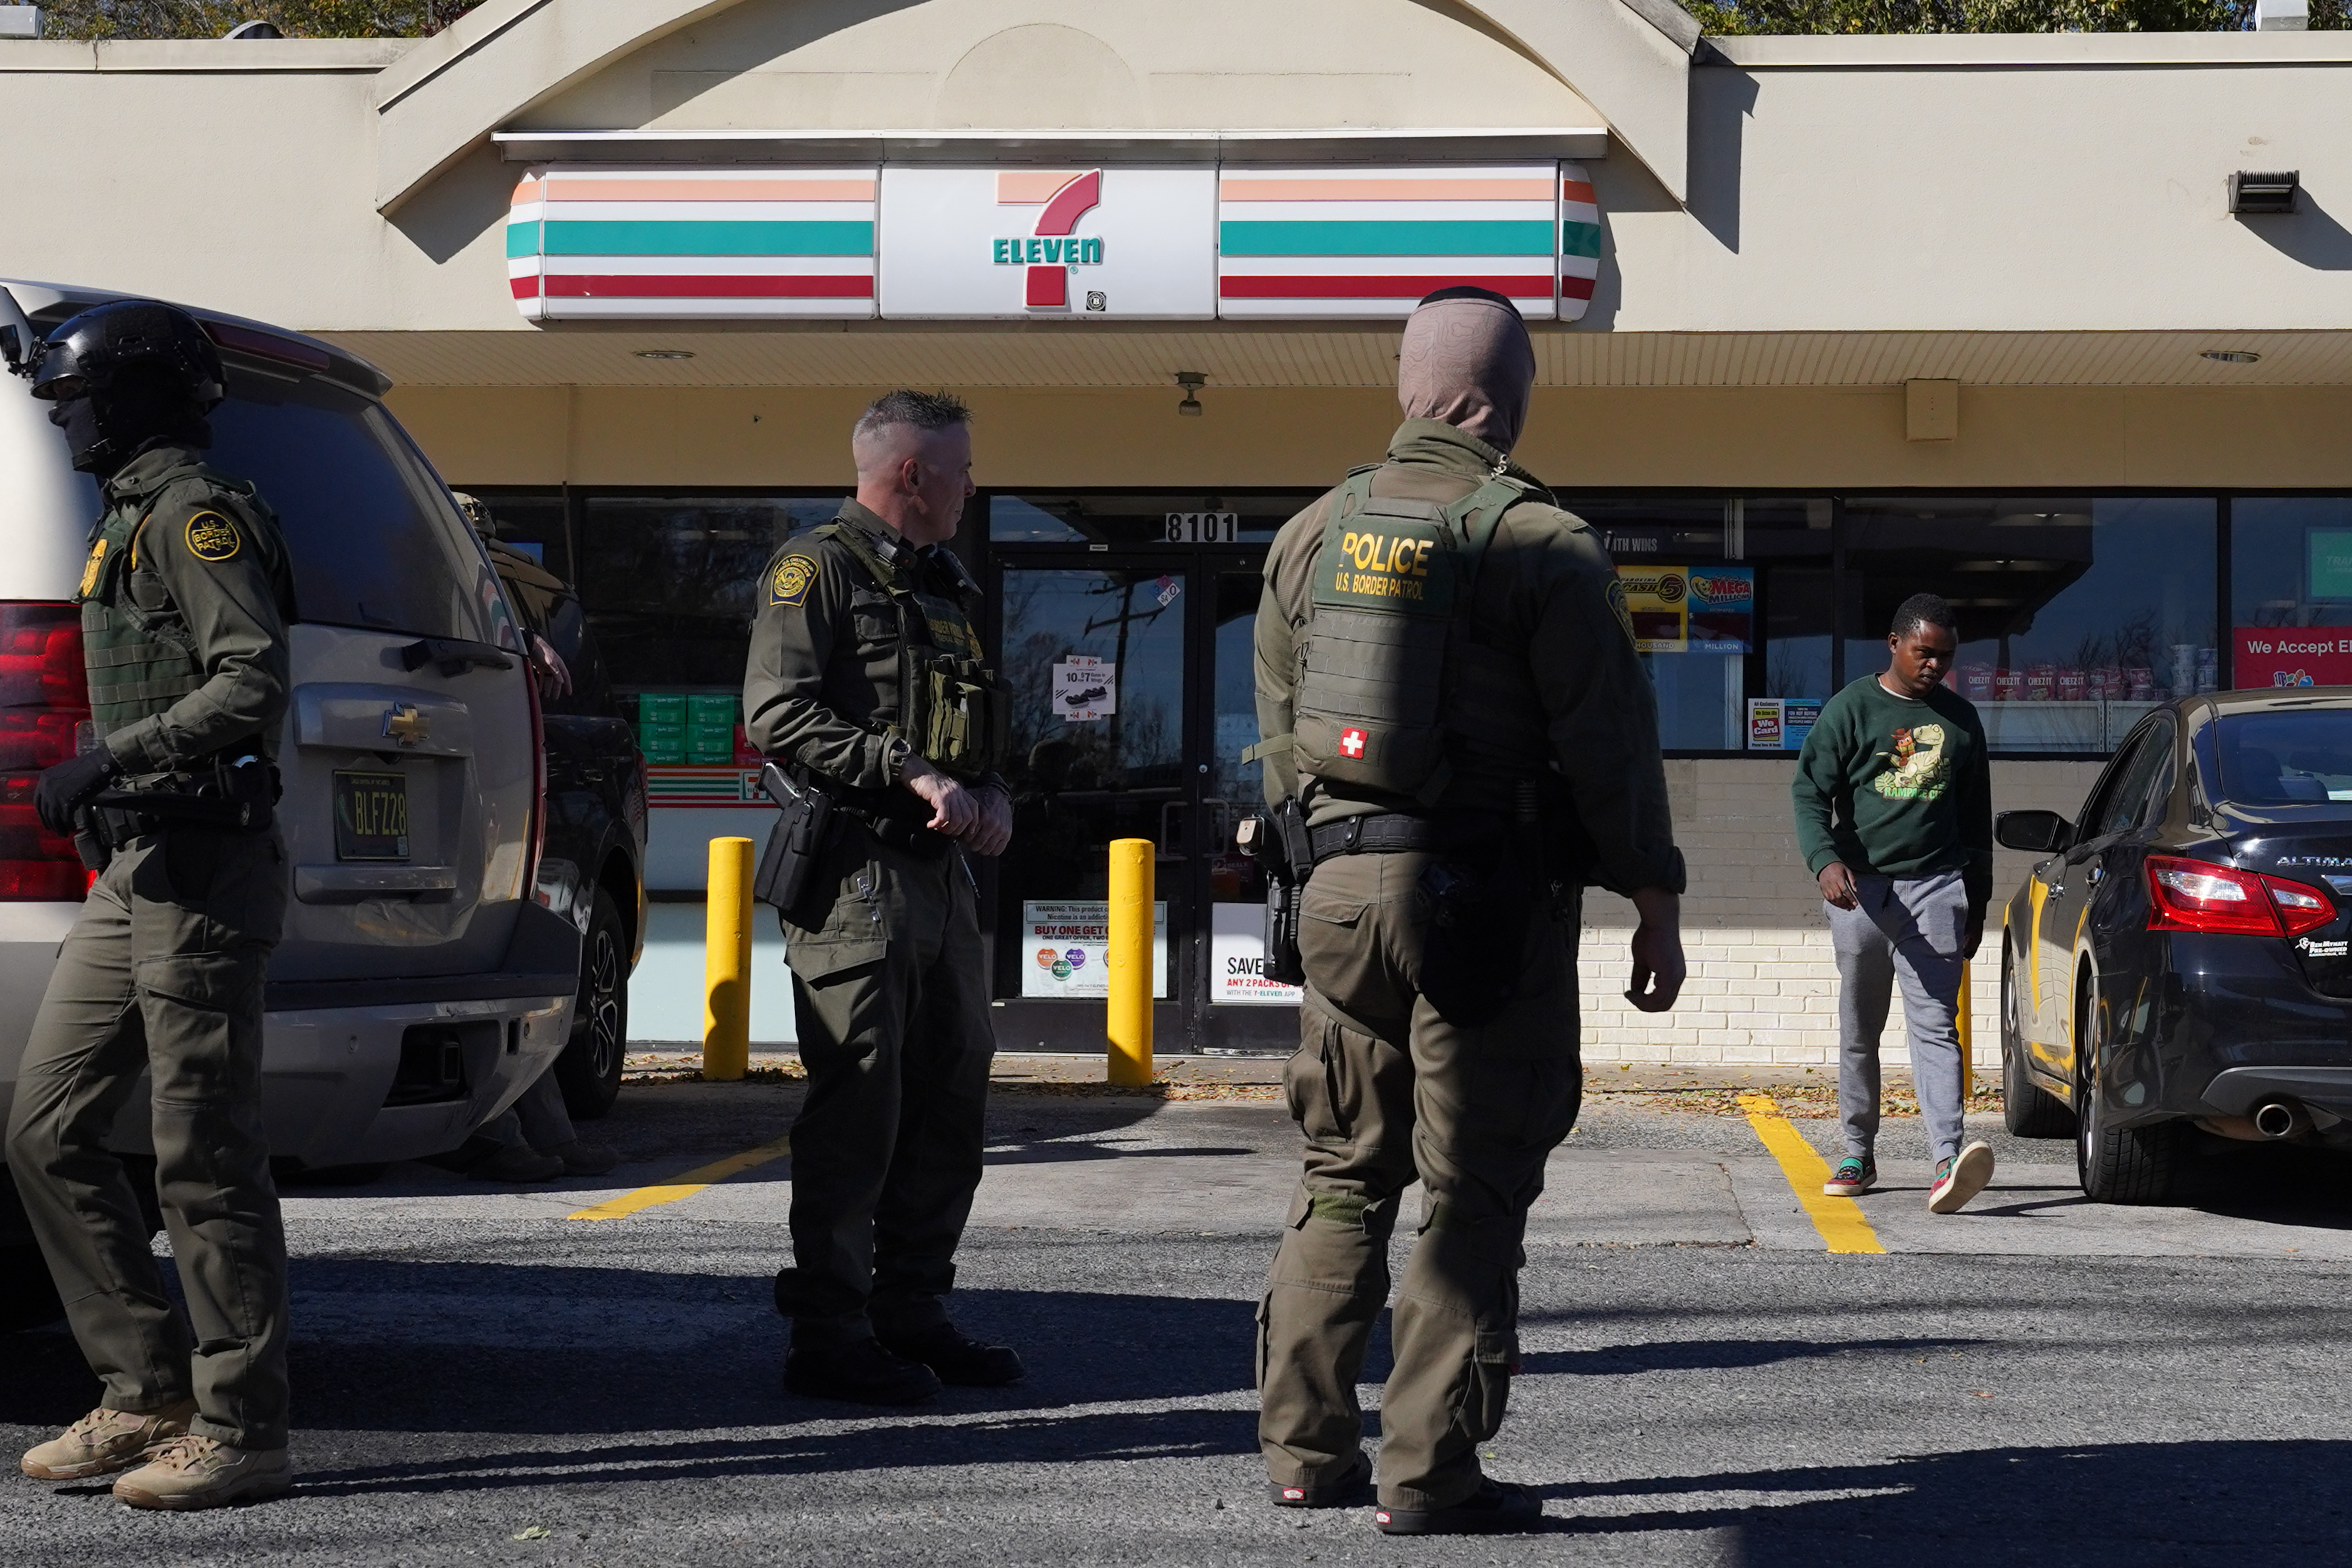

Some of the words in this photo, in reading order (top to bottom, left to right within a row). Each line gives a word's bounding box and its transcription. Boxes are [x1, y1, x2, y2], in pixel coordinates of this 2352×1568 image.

[998, 171, 1099, 306] 7
[200, 519, 219, 529] U.S.
[1167, 513, 1234, 542] 8101
[192, 530, 230, 543] BORDER
[197, 537, 236, 552] PATROL
[1632, 538, 1658, 552] WINS
[1338, 532, 1435, 576] POLICE
[1335, 572, 1350, 592] U.S.
[1352, 574, 1388, 596] BORDER
[1388, 577, 1423, 600] PATROL
[1659, 580, 1684, 597] 5
[1710, 579, 1749, 595] MEGA
[1169, 585, 1177, 596] 0
[1708, 593, 1750, 604] MILLIONS
[2247, 640, 2272, 654] We
[2276, 640, 2334, 657] Accept
[2338, 640, 2352, 653] E
[1066, 672, 1078, 682] 10
[1754, 726, 1778, 735] Card
[1034, 926, 1057, 935] BUY
[1058, 926, 1081, 934] ONE
[1083, 926, 1104, 934] GET
[1227, 957, 1264, 975] SAVE
[1252, 979, 1279, 988] PACKS
